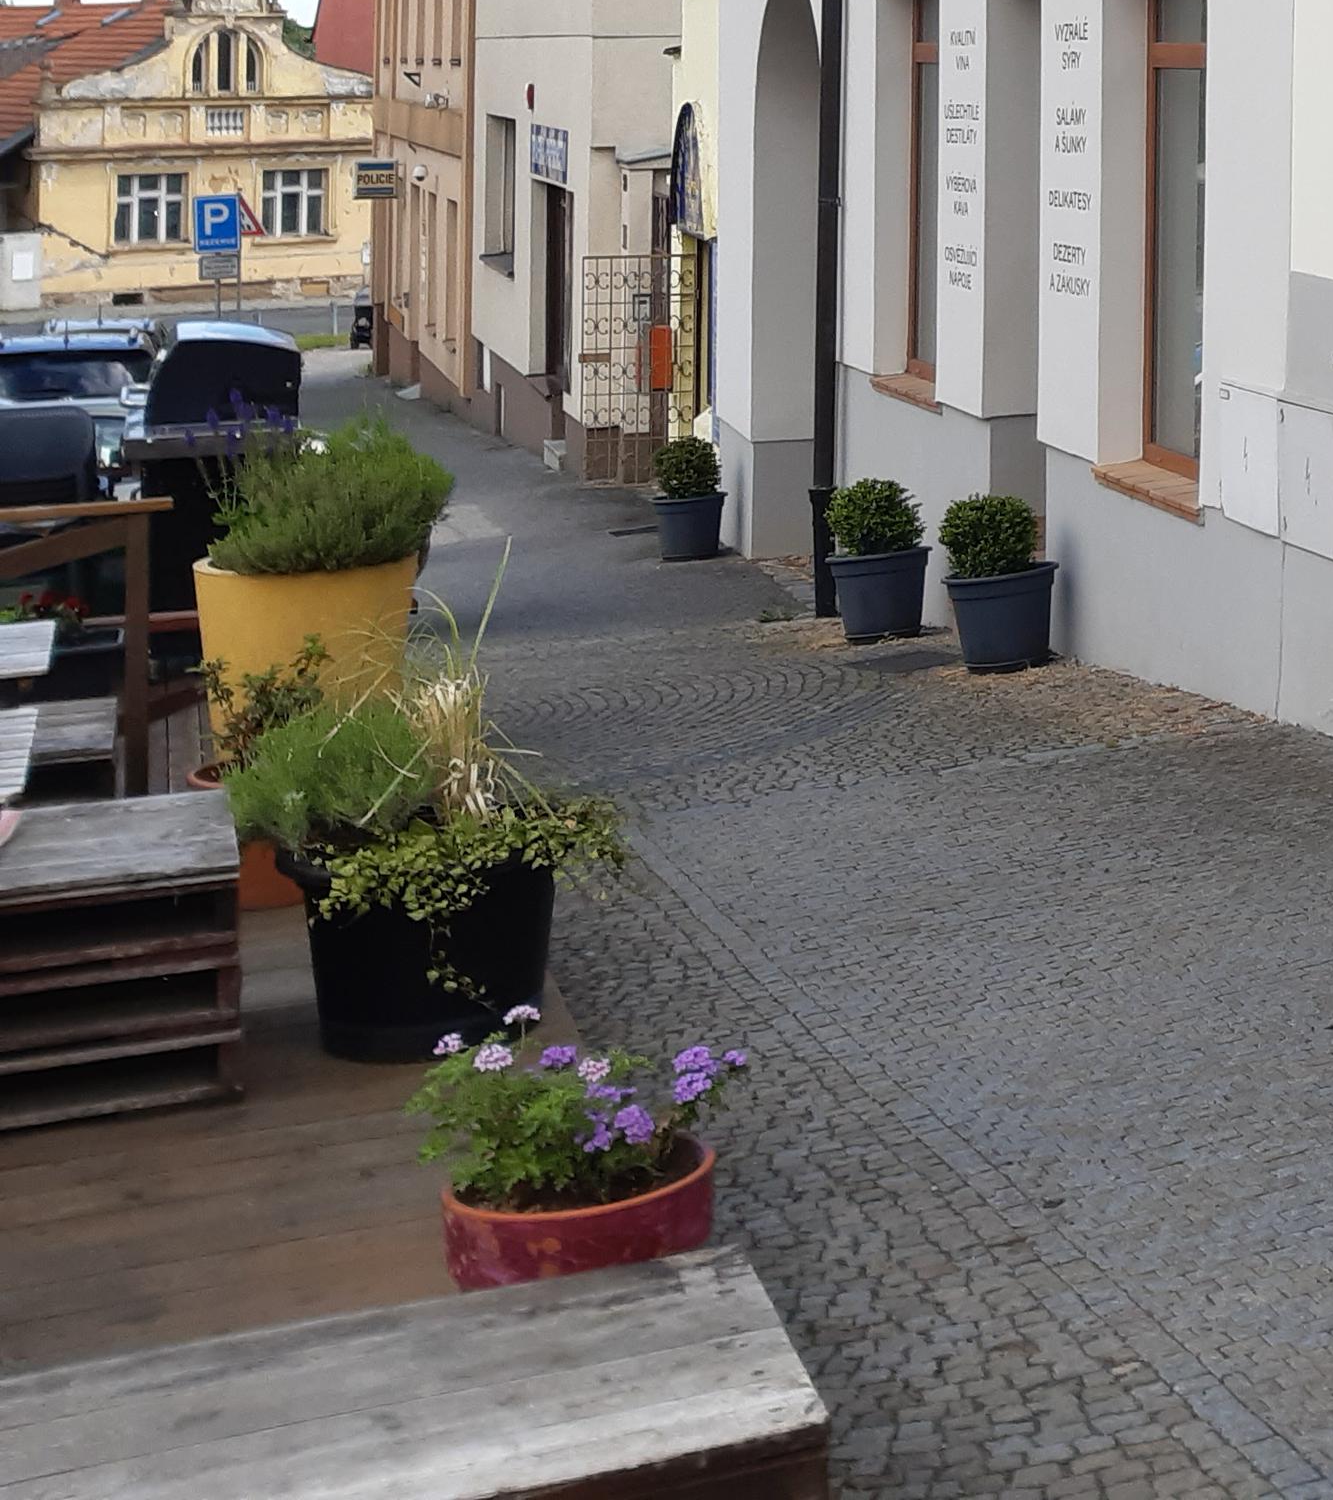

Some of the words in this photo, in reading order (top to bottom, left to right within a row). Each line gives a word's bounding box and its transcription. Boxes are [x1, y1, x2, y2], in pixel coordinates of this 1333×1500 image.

[1054, 15, 1088, 42] VYZRÁLÉ
[1061, 44, 1081, 70] SÝRY
[1056, 100, 1087, 126] SALÁMY
[1054, 135, 1061, 153] A
[1061, 130, 1087, 154] ŠUNKY
[357, 173, 395, 186] POLICIE
[1049, 190, 1091, 211] DELIKATESY
[204, 203, 229, 236] P
[1053, 243, 1086, 266] DEZERTY
[1056, 269, 1090, 296] ZÁKUSKY
